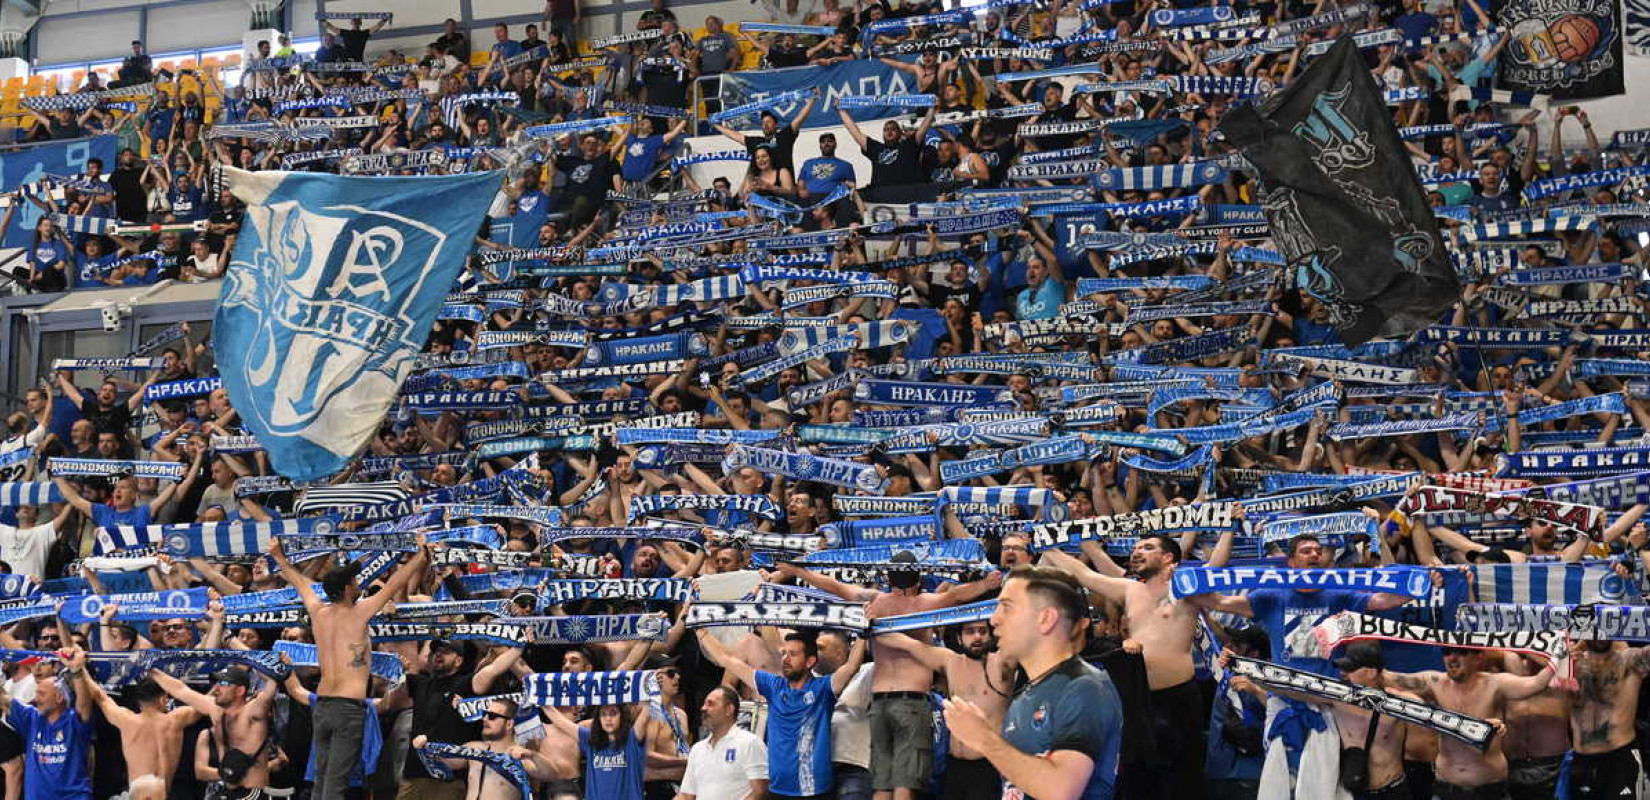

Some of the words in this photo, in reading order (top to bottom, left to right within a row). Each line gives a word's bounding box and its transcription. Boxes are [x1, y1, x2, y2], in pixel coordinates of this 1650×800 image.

[298, 117, 366, 127] ΗΡΑΚΛΗΣ
[1529, 267, 1607, 282] ΗΡΑΚΛΗΣ
[1530, 295, 1643, 315] ΗΡΑΚΛΗ
[1427, 330, 1560, 342] ΗΡΑΚΛΗΣ
[615, 342, 673, 357] ΗΡΑΚΛΗΣ
[561, 359, 684, 379] ΗΡΑΚΛΗΣ
[1315, 363, 1403, 382] ΑΚΛΗΣ
[148, 379, 222, 398] ΗΡΑΚΛΗ
[407, 391, 516, 404] ΗΡΑΚΛΗΣ
[891, 386, 977, 404] ΗΡΑΚΛΗΣ
[528, 399, 642, 417] ΗΡΑΚΛΗΣ
[747, 449, 789, 474] FORZA
[820, 461, 857, 483] ΗΡΑ
[861, 523, 931, 541] ΗΡΑΚΛΗ
[1205, 567, 1398, 589] ΗΡΑΚΛΗΣ
[548, 579, 692, 602] ΗΡΑΚΛΗ
[226, 610, 299, 623] RAKLIS
[595, 616, 631, 637] ΗΡΑ
[1359, 615, 1556, 652] BUKANEROS
